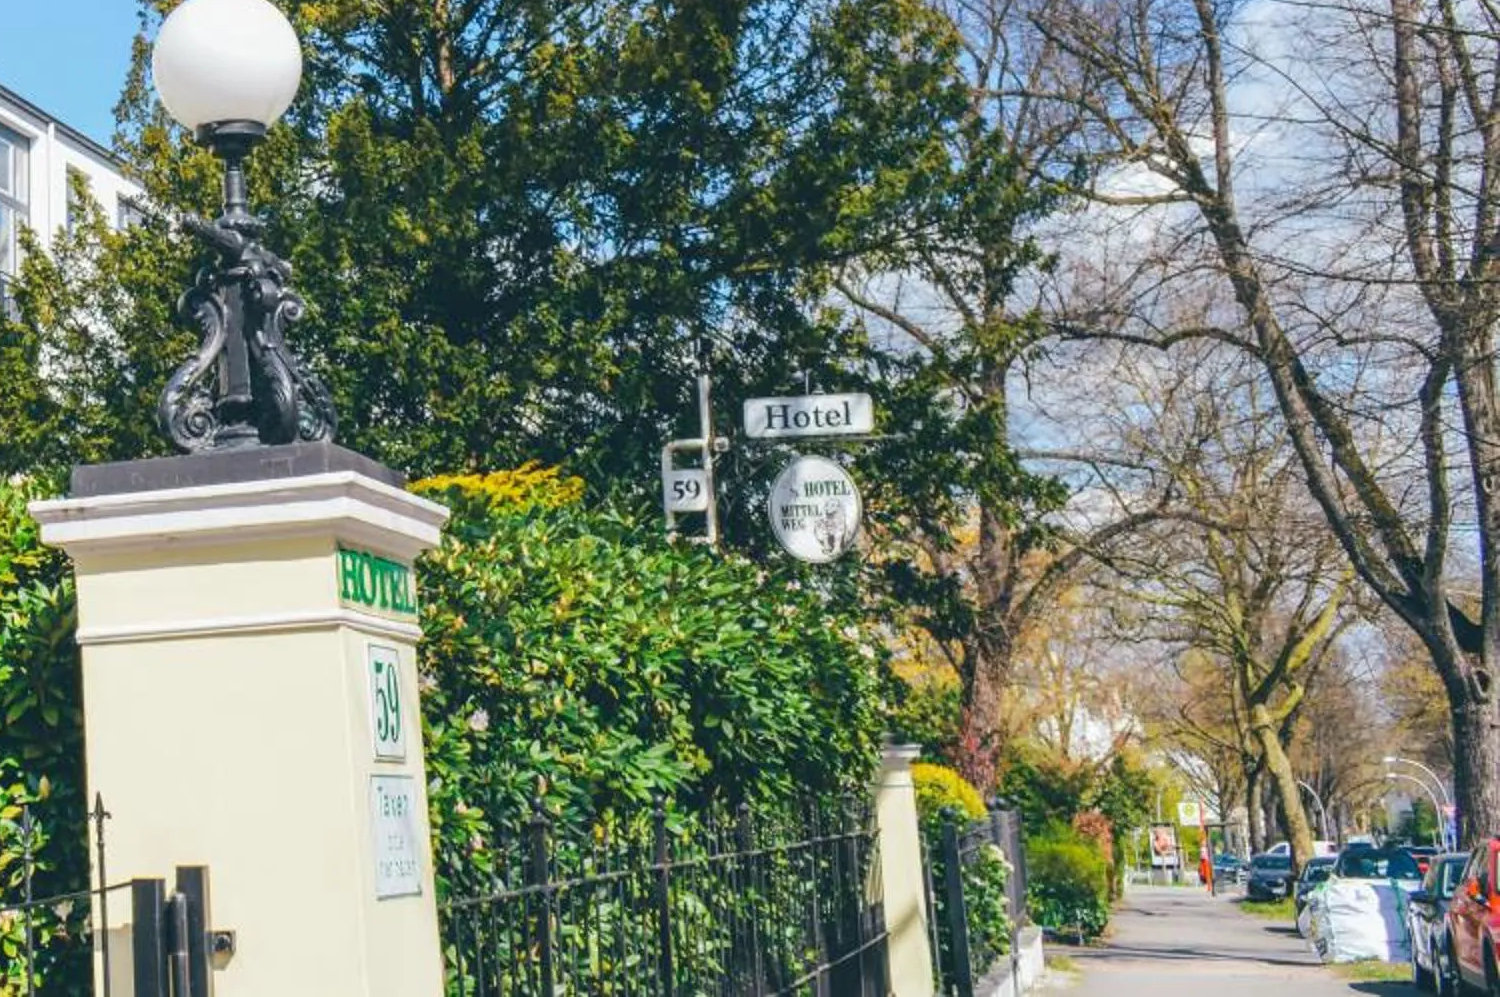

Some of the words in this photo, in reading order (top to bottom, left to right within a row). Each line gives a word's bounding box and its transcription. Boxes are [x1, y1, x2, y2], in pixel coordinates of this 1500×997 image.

[765, 400, 852, 430] Hotel
[672, 479, 700, 500] 59
[804, 480, 850, 497] HOTEL
[781, 505, 822, 517] MITTEL
[340, 549, 416, 614] HOTEL
[375, 661, 400, 742] 59
